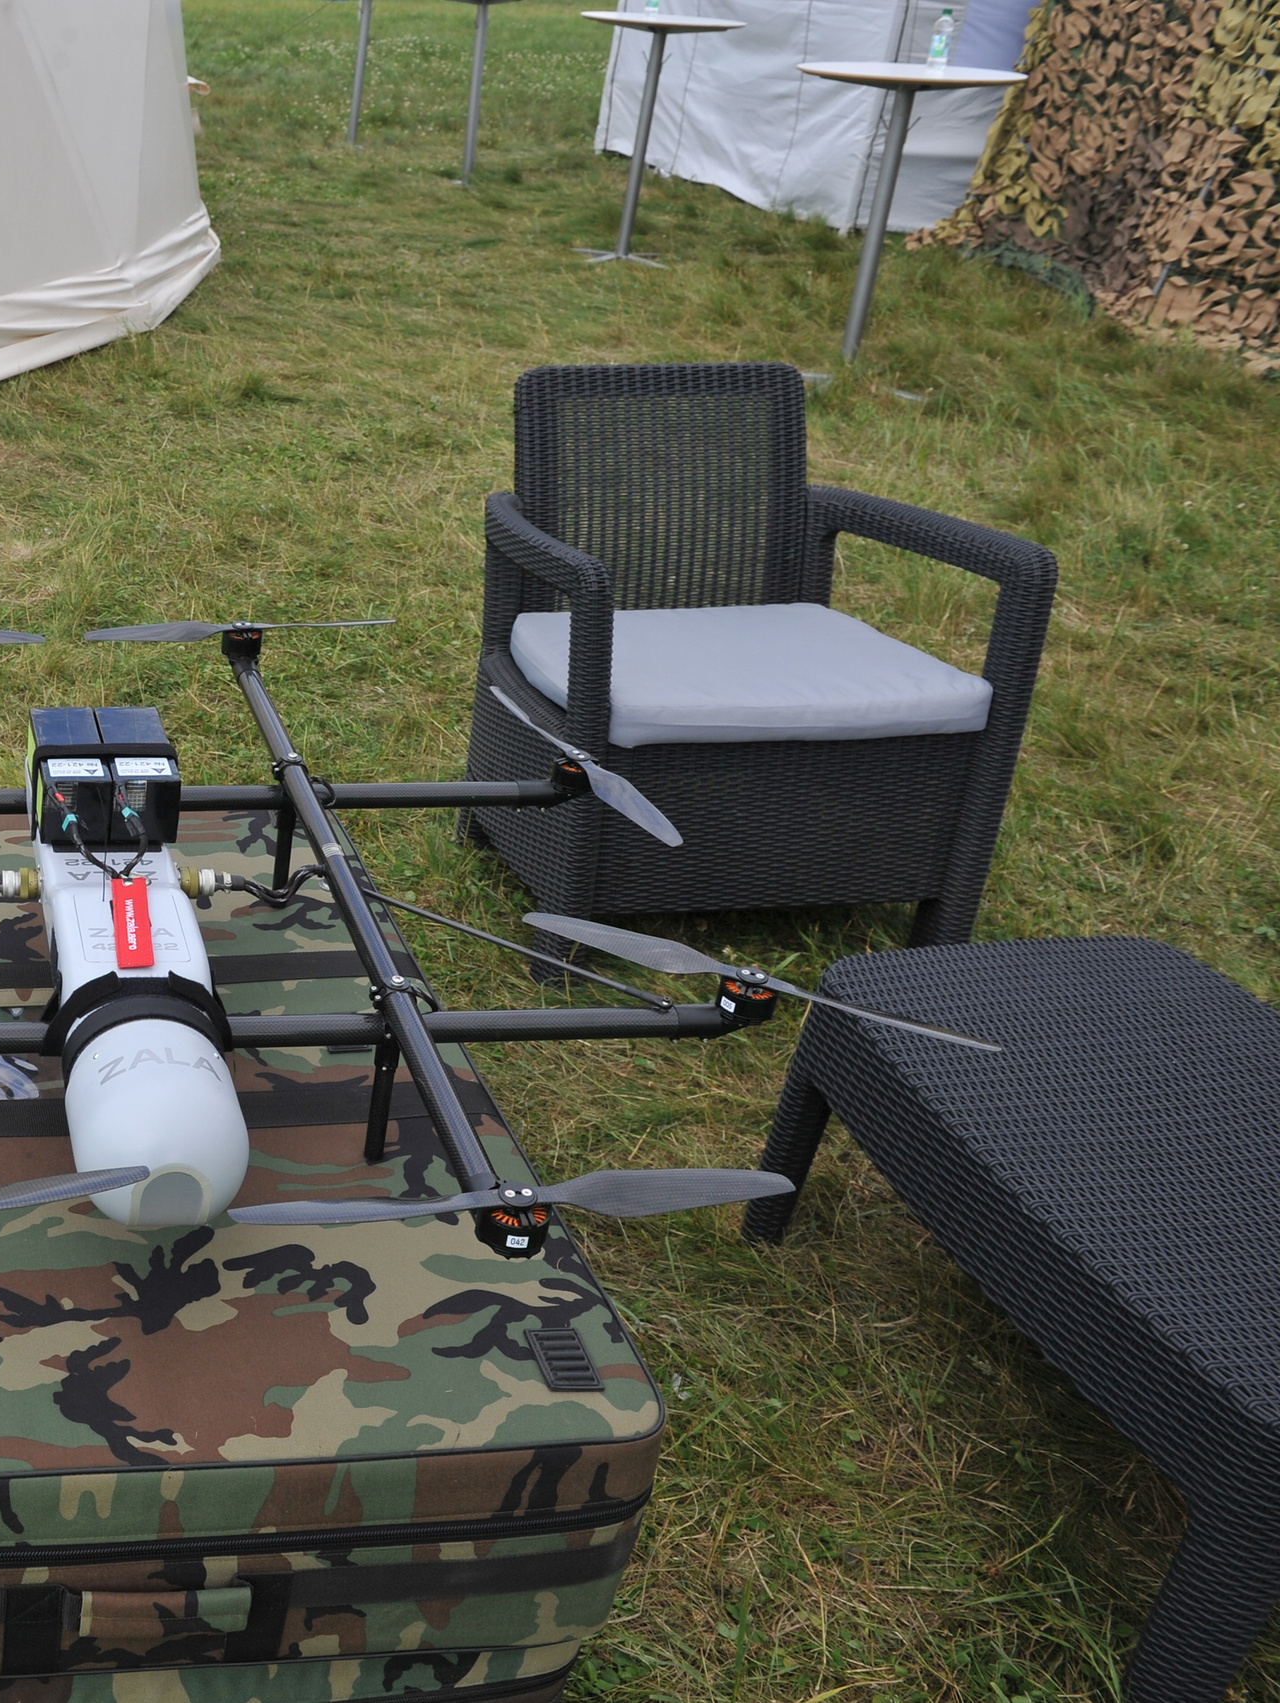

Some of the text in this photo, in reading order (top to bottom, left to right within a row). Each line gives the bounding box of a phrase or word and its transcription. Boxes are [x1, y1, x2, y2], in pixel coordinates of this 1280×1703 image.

[67, 871, 158, 881] ZLA
[124, 898, 139, 951] www.zala.aero
[98, 1047, 222, 1086] ZALA
[510, 1237, 526, 1246] 042
